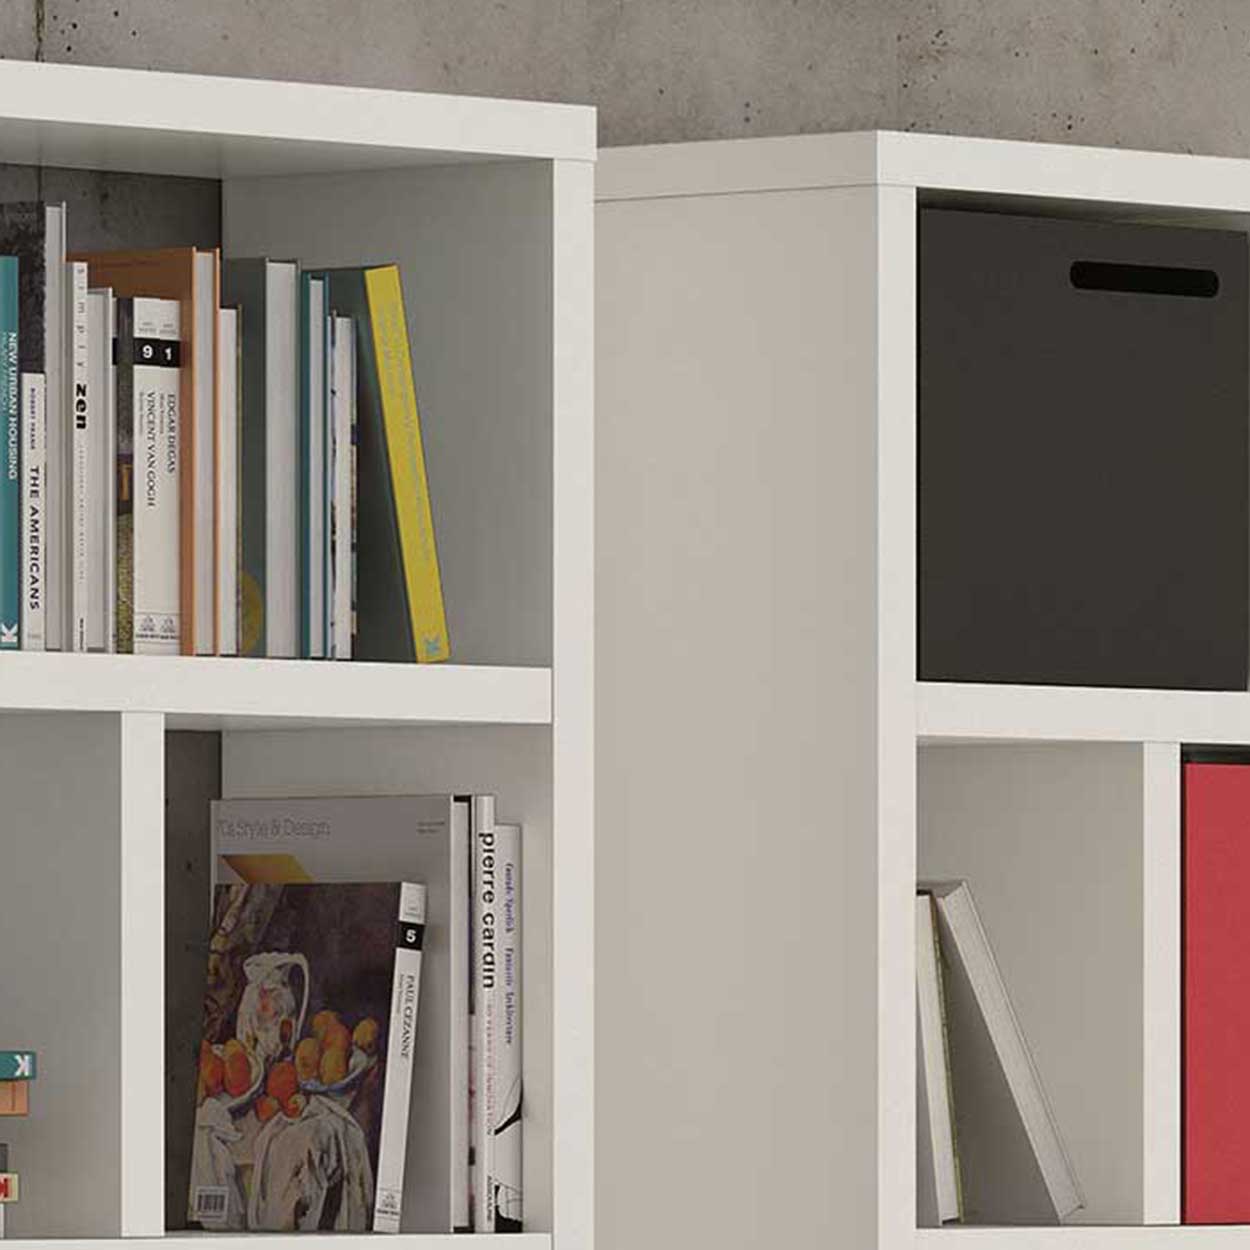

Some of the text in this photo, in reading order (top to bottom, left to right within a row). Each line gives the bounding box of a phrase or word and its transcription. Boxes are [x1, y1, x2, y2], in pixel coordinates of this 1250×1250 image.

[8, 332, 18, 362] NEW
[142, 345, 153, 359] 9
[165, 347, 172, 360] 1
[76, 383, 87, 429] zen
[8, 417, 18, 479] HOUSING
[146, 392, 155, 507] VINCENT VAN GOGH
[167, 394, 175, 474] EDGAR DEGAS
[30, 465, 39, 610] THE AMERICANS
[479, 833, 496, 988] pierre cardin
[404, 975, 415, 1005] PAUL
